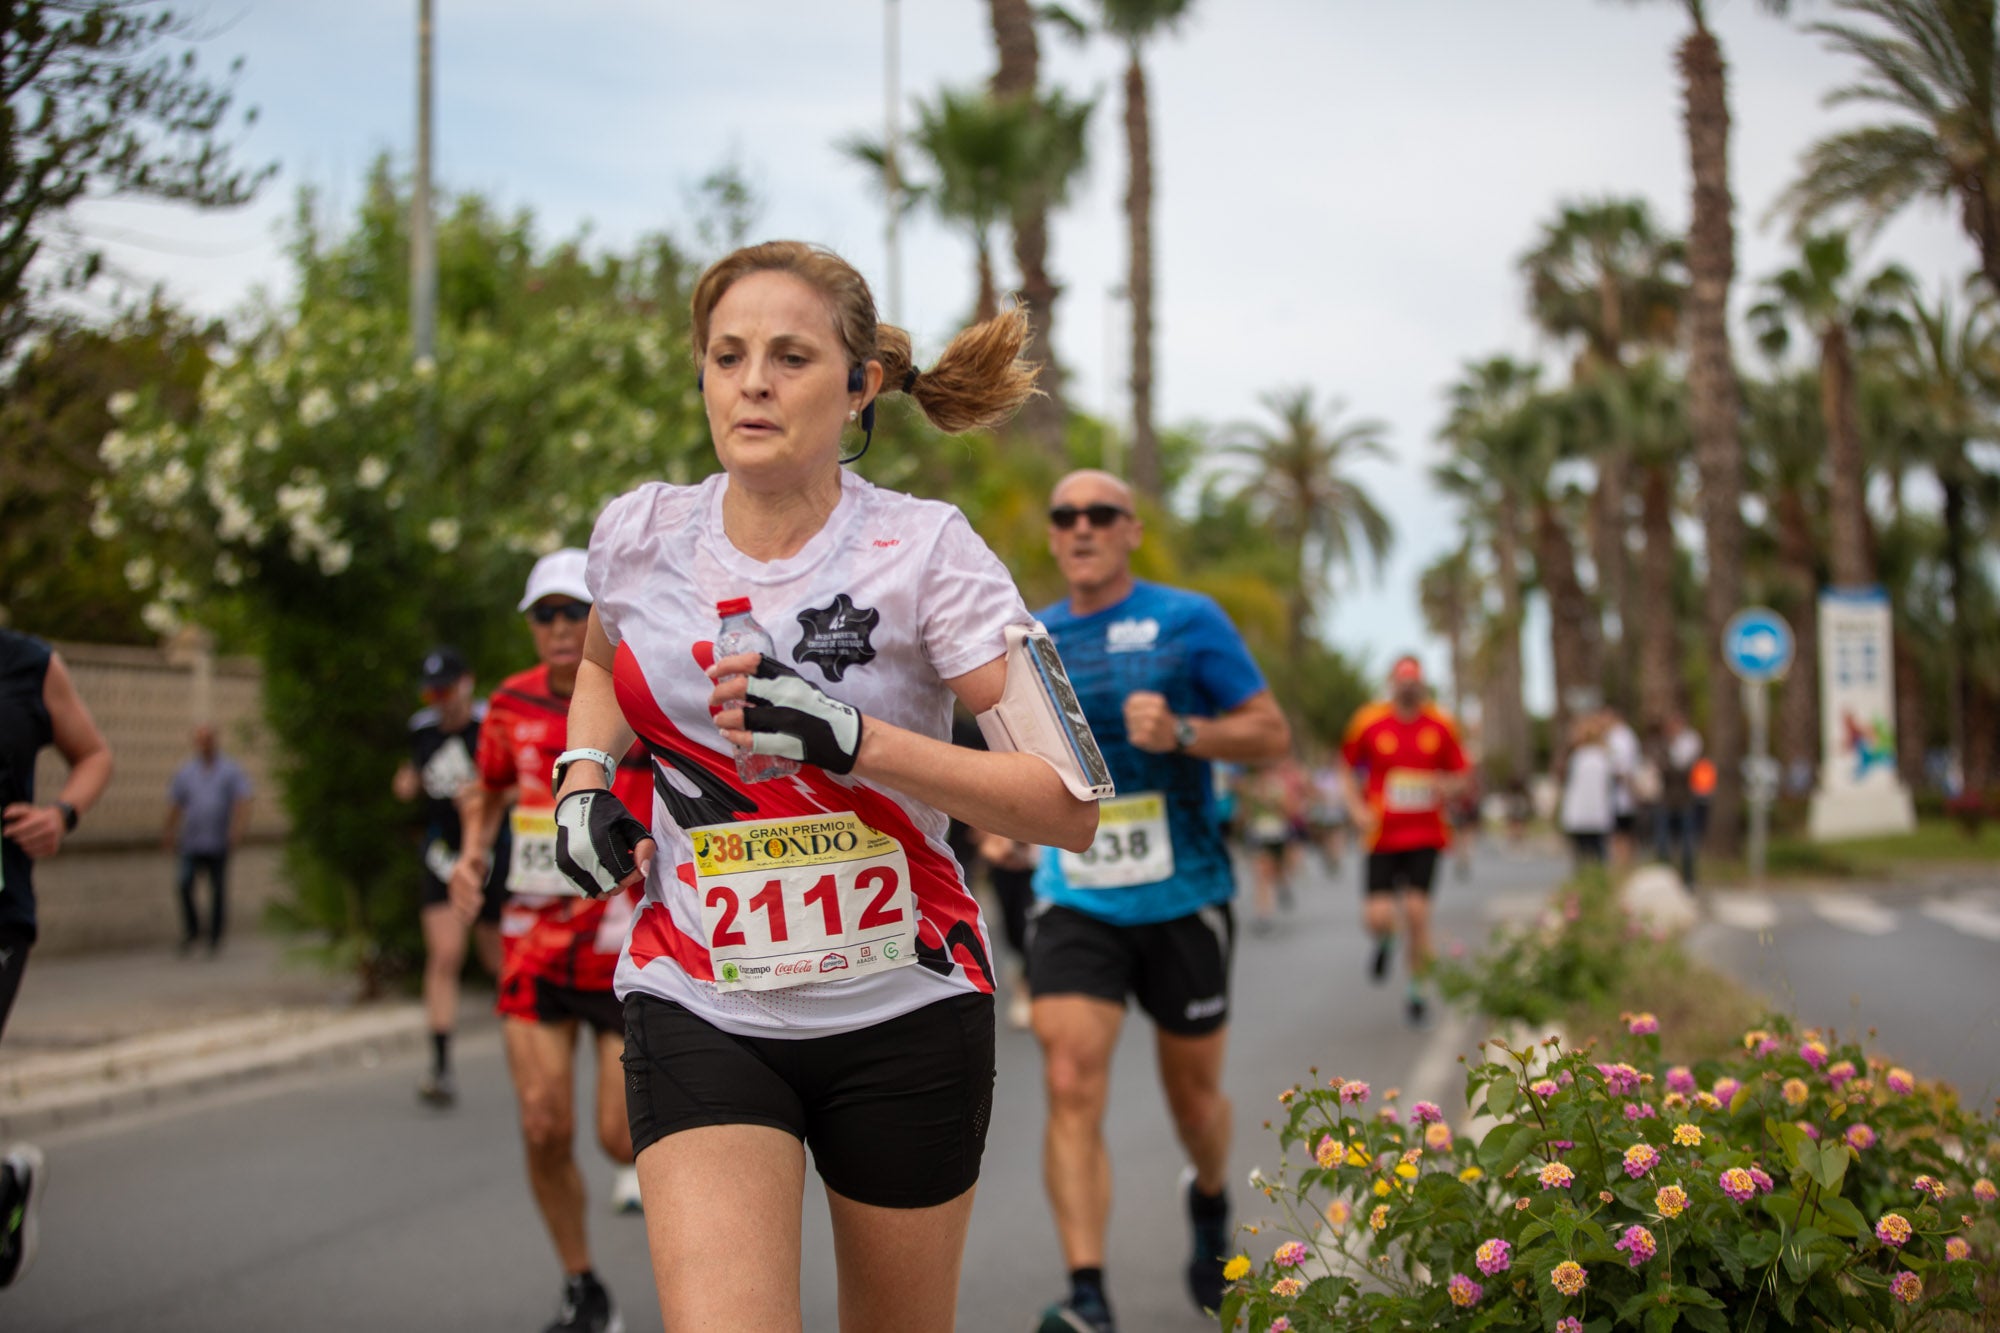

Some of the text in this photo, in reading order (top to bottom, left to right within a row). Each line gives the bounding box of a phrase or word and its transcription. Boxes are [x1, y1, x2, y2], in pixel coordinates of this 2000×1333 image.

[712, 830, 858, 863] 38 FONDO
[749, 827, 790, 840] GRAN
[792, 820, 846, 836] PREMIO
[705, 865, 904, 950] 2112
